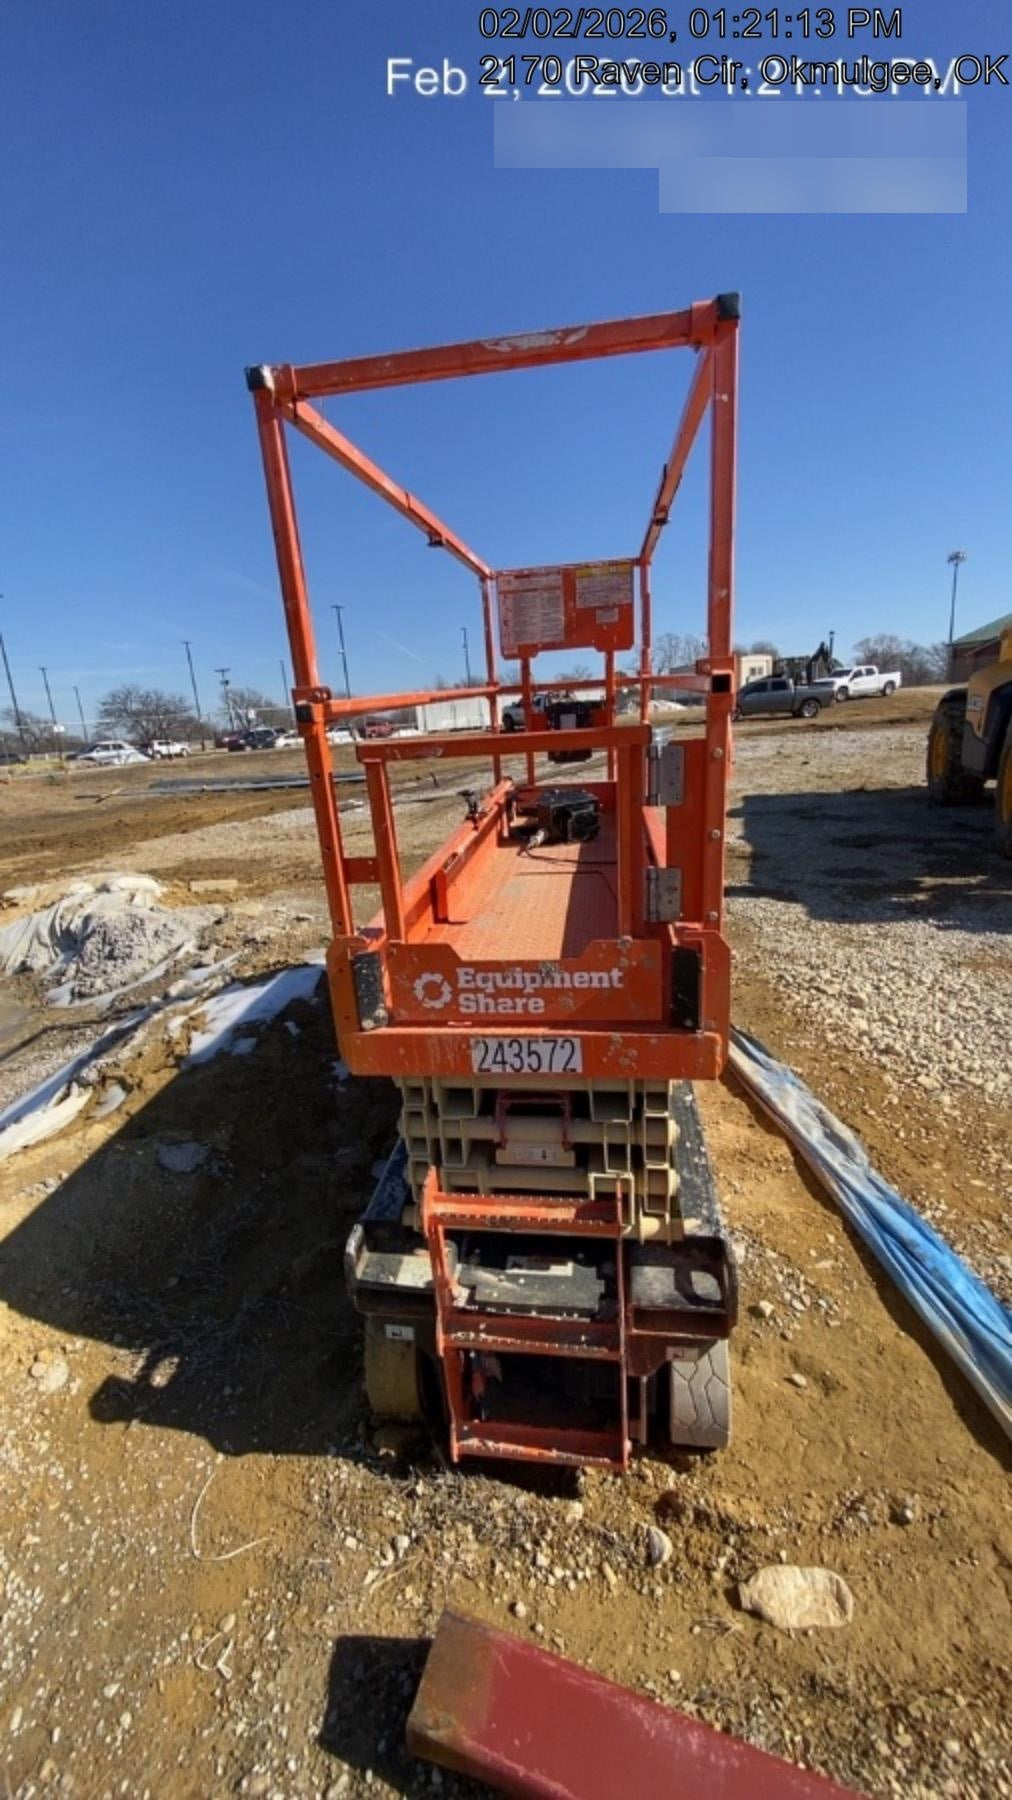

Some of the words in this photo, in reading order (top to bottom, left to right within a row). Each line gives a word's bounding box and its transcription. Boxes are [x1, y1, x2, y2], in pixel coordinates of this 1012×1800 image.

[456, 966, 624, 991] Equipment
[458, 991, 546, 1015] Share
[475, 1037, 578, 1074] 243572
